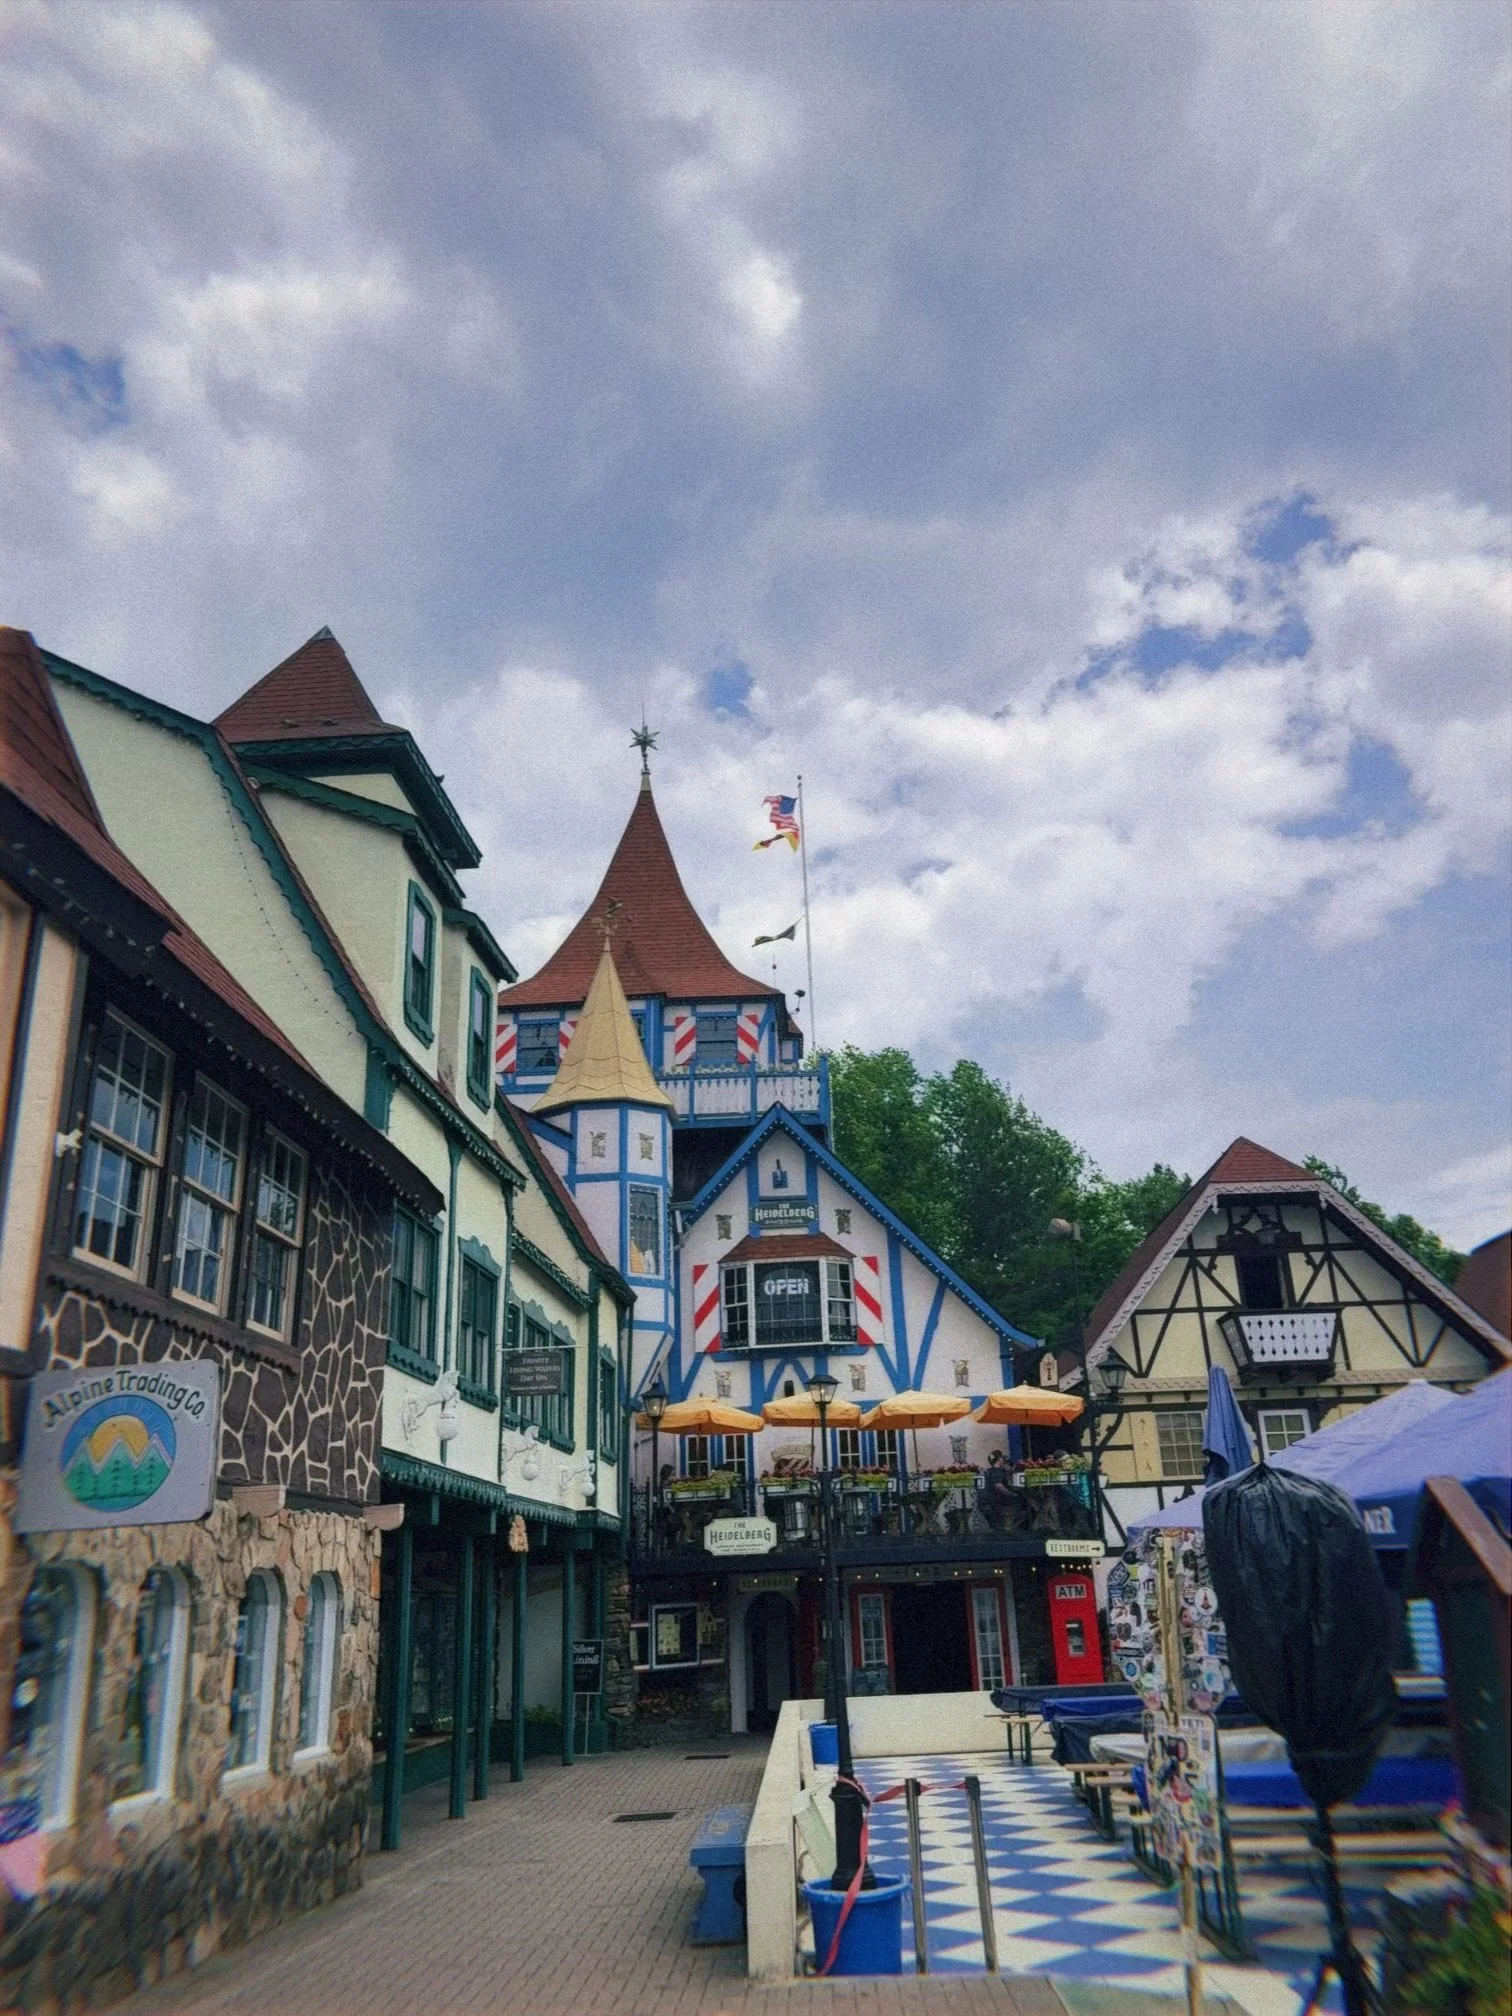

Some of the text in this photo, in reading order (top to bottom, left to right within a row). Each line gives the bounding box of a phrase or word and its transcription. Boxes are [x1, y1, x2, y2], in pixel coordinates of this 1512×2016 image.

[754, 1206, 815, 1221] HEIDELBERG
[764, 1278, 809, 1295] OPEN
[42, 1370, 206, 1427] Alpine Trading Co.
[710, 1527, 771, 1545] HEIDELBERG
[1050, 1544, 1090, 1552] RESTROOMS
[1059, 1585, 1084, 1598] ATM
[573, 1654, 600, 1665] ining
